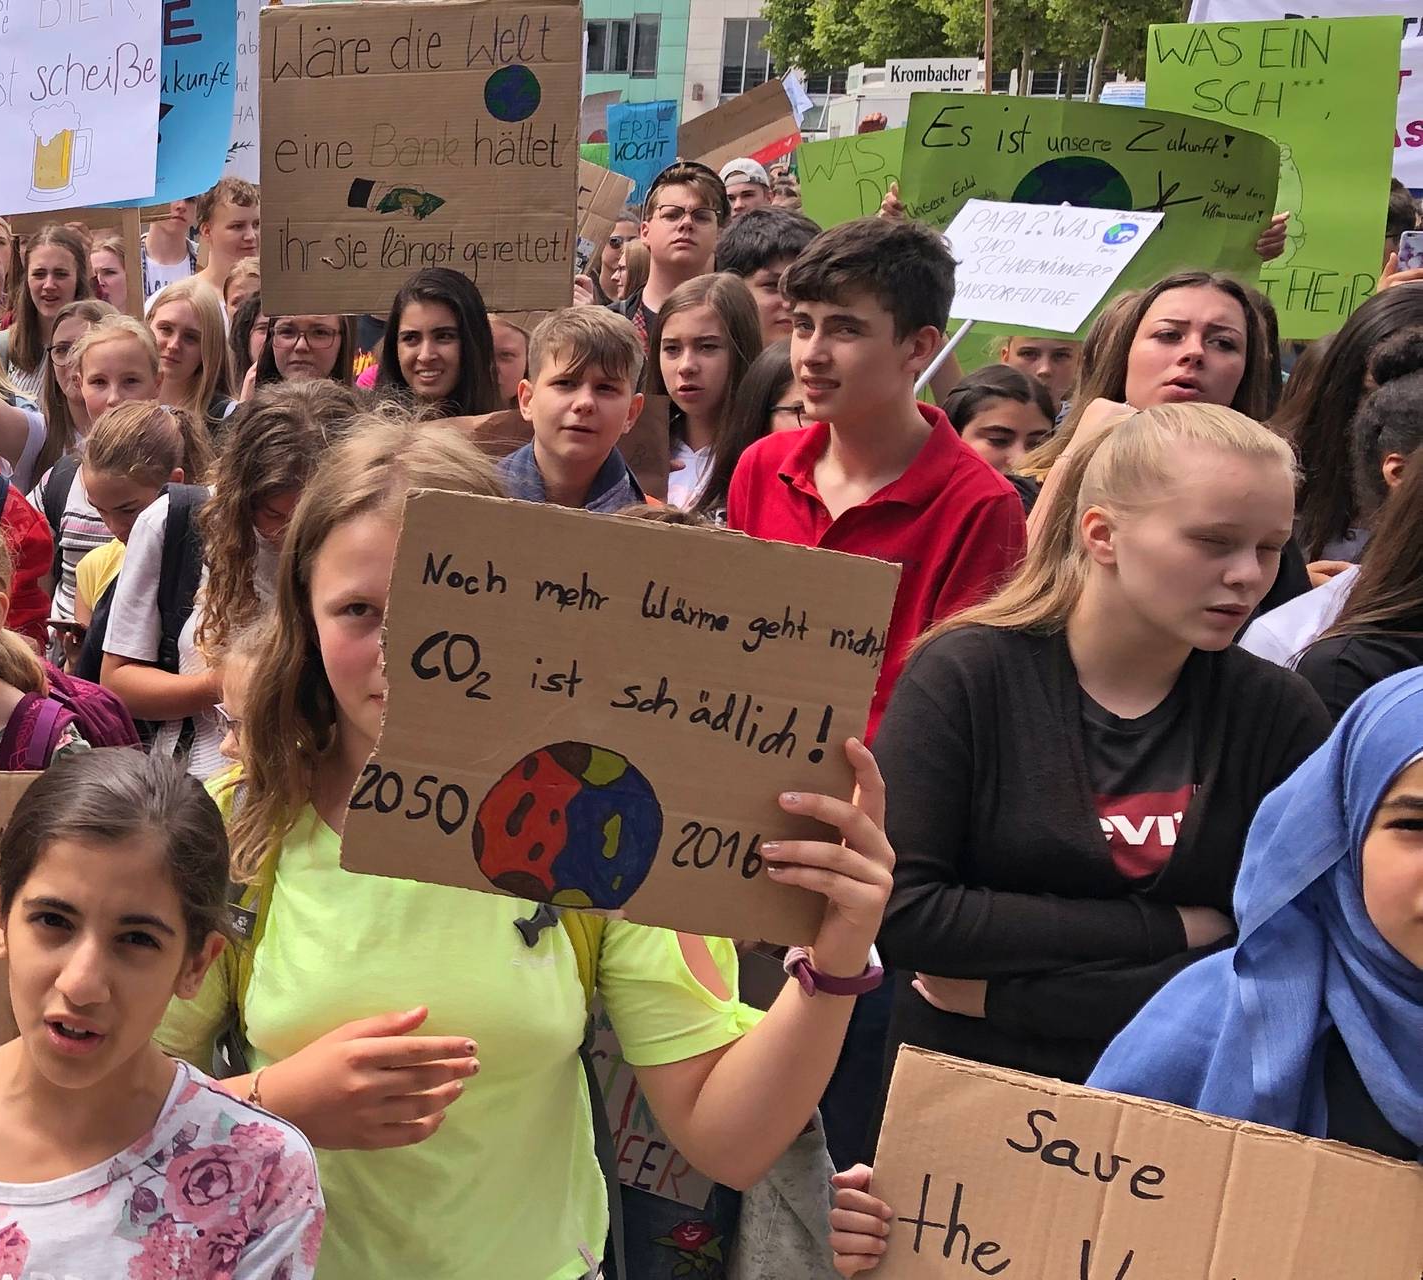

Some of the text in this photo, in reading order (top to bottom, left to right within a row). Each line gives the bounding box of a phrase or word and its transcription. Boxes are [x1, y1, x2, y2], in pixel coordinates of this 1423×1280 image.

[30, 42, 157, 101] scheiße
[273, 14, 553, 83] Wäre die Welt
[1154, 25, 1332, 69] WAS EIN
[160, 60, 231, 99] ukunft
[890, 64, 973, 83] Krombacher
[274, 134, 354, 173] eine
[368, 121, 464, 168] Bank
[614, 140, 670, 162] KOCHT
[618, 119, 673, 141] ERDE
[921, 104, 1236, 159] Es ist unsere Zukunft!
[801, 137, 886, 183] WAS
[321, 233, 369, 270] sie
[380, 226, 455, 270] längst
[462, 229, 569, 284] gerettet!
[970, 236, 1016, 254] SIND
[954, 280, 1080, 307] DAYSFORFUTURE
[422, 552, 508, 595] Noch
[535, 572, 610, 613] mehr
[641, 580, 730, 633] Wärme
[741, 605, 810, 652] geht
[530, 657, 584, 699] ist
[349, 764, 763, 880] 2050 2016
[1005, 1109, 1166, 1200] Save
[897, 1173, 1011, 1276] the
